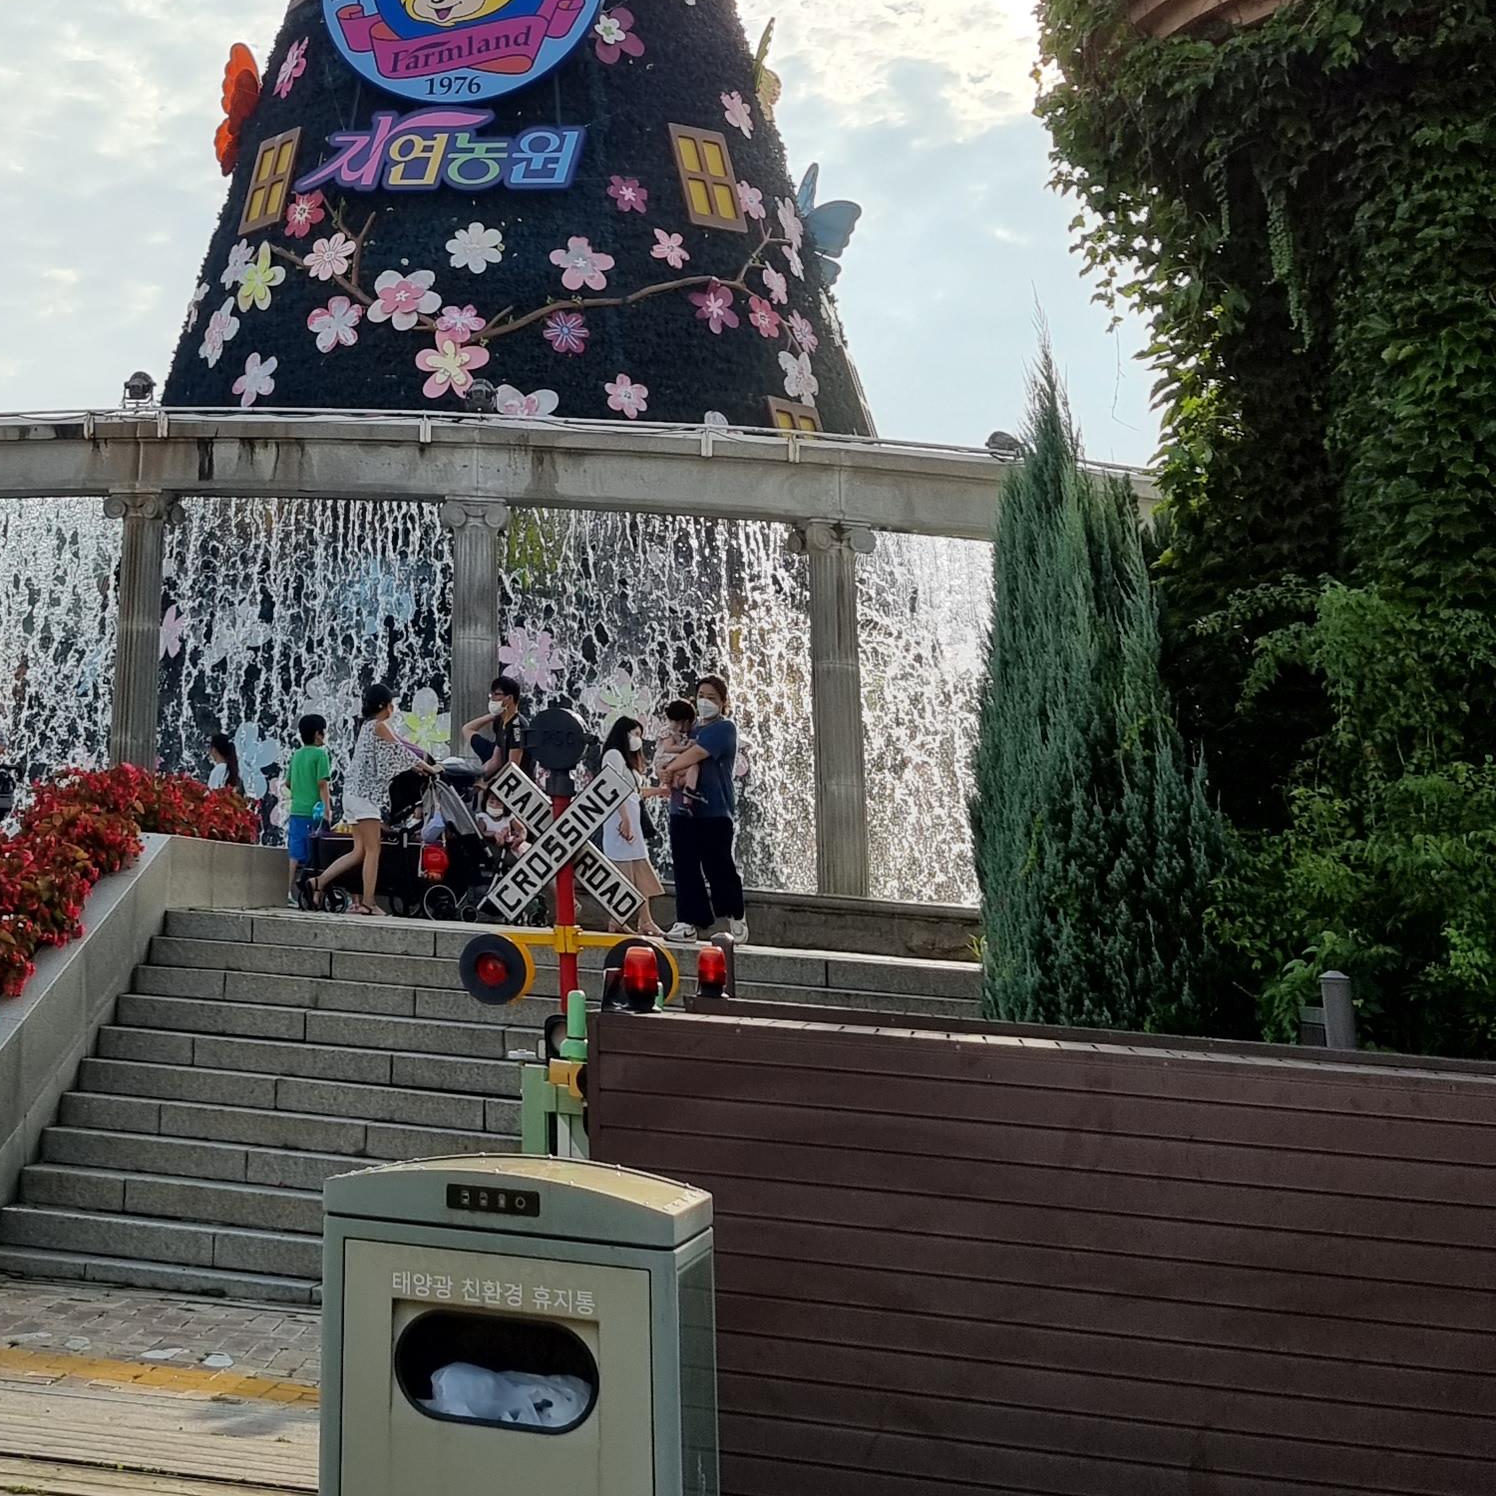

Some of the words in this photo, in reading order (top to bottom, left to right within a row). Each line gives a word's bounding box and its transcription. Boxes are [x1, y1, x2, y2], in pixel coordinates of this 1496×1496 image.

[389, 25, 532, 74] Farmland
[424, 75, 482, 96] 1976
[296, 109, 581, 187] 자연농원
[494, 778, 620, 914] CROSSING
[496, 771, 553, 835] RAIL
[575, 850, 638, 918] ROAD
[391, 1271, 454, 1300] 태양광
[461, 1277, 524, 1307] 친환경
[531, 1284, 596, 1316] 휴지통
